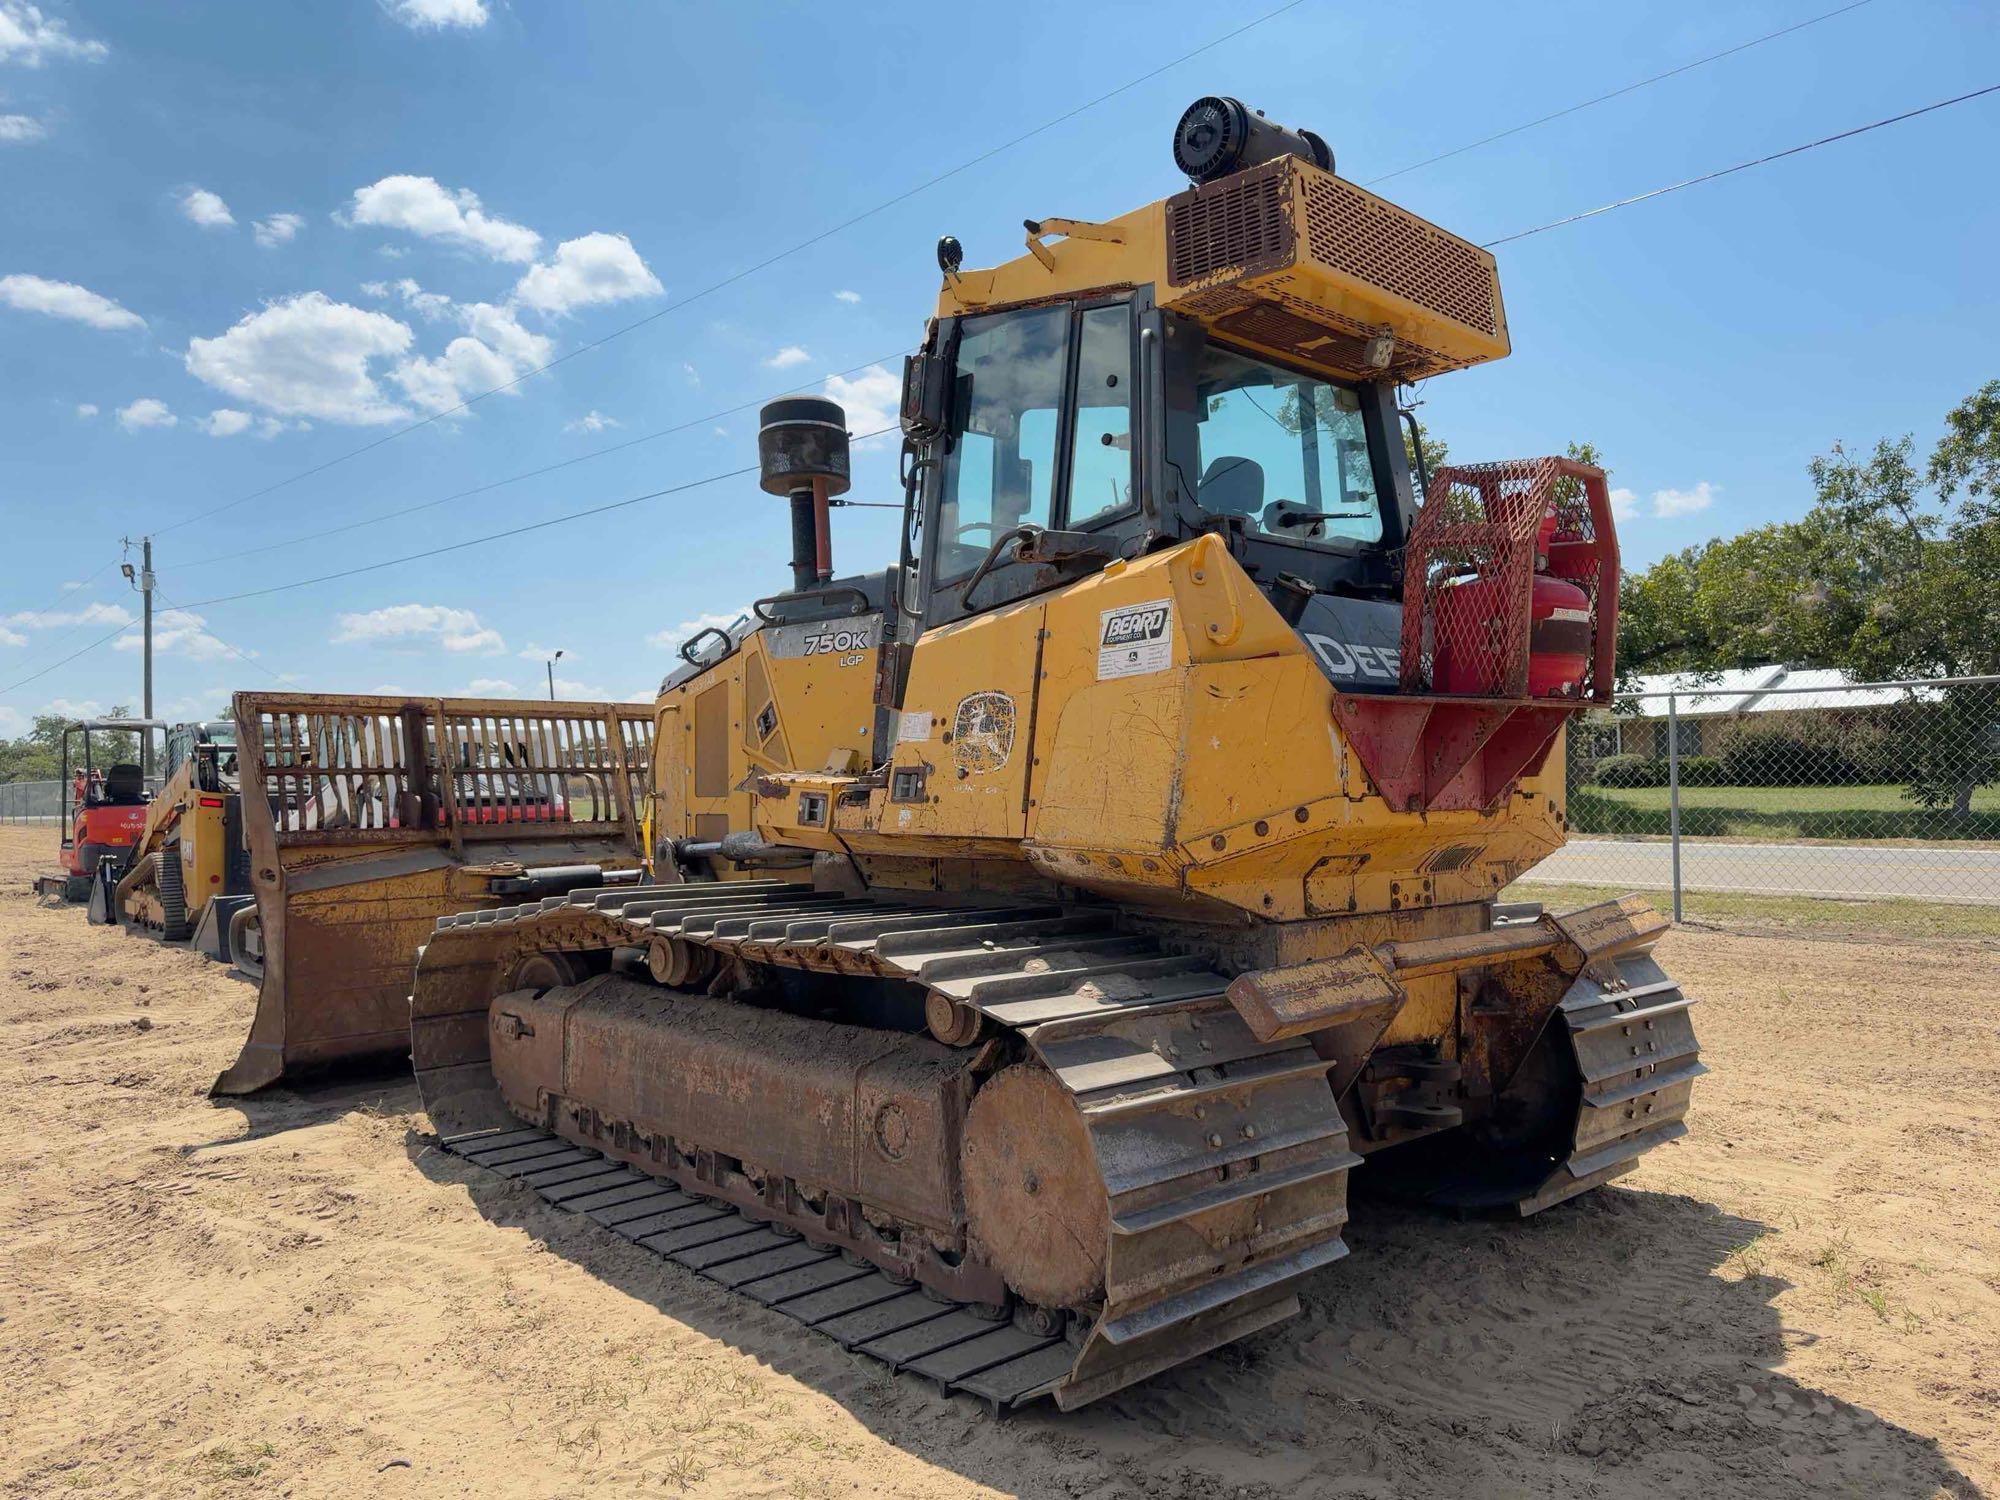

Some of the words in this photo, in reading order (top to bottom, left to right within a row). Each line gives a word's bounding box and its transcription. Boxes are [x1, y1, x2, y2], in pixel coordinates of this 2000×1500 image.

[1107, 610, 1164, 640] BEARD
[804, 631, 869, 656] 750K
[1304, 633, 1401, 678] DEE
[840, 654, 864, 667] LGP
